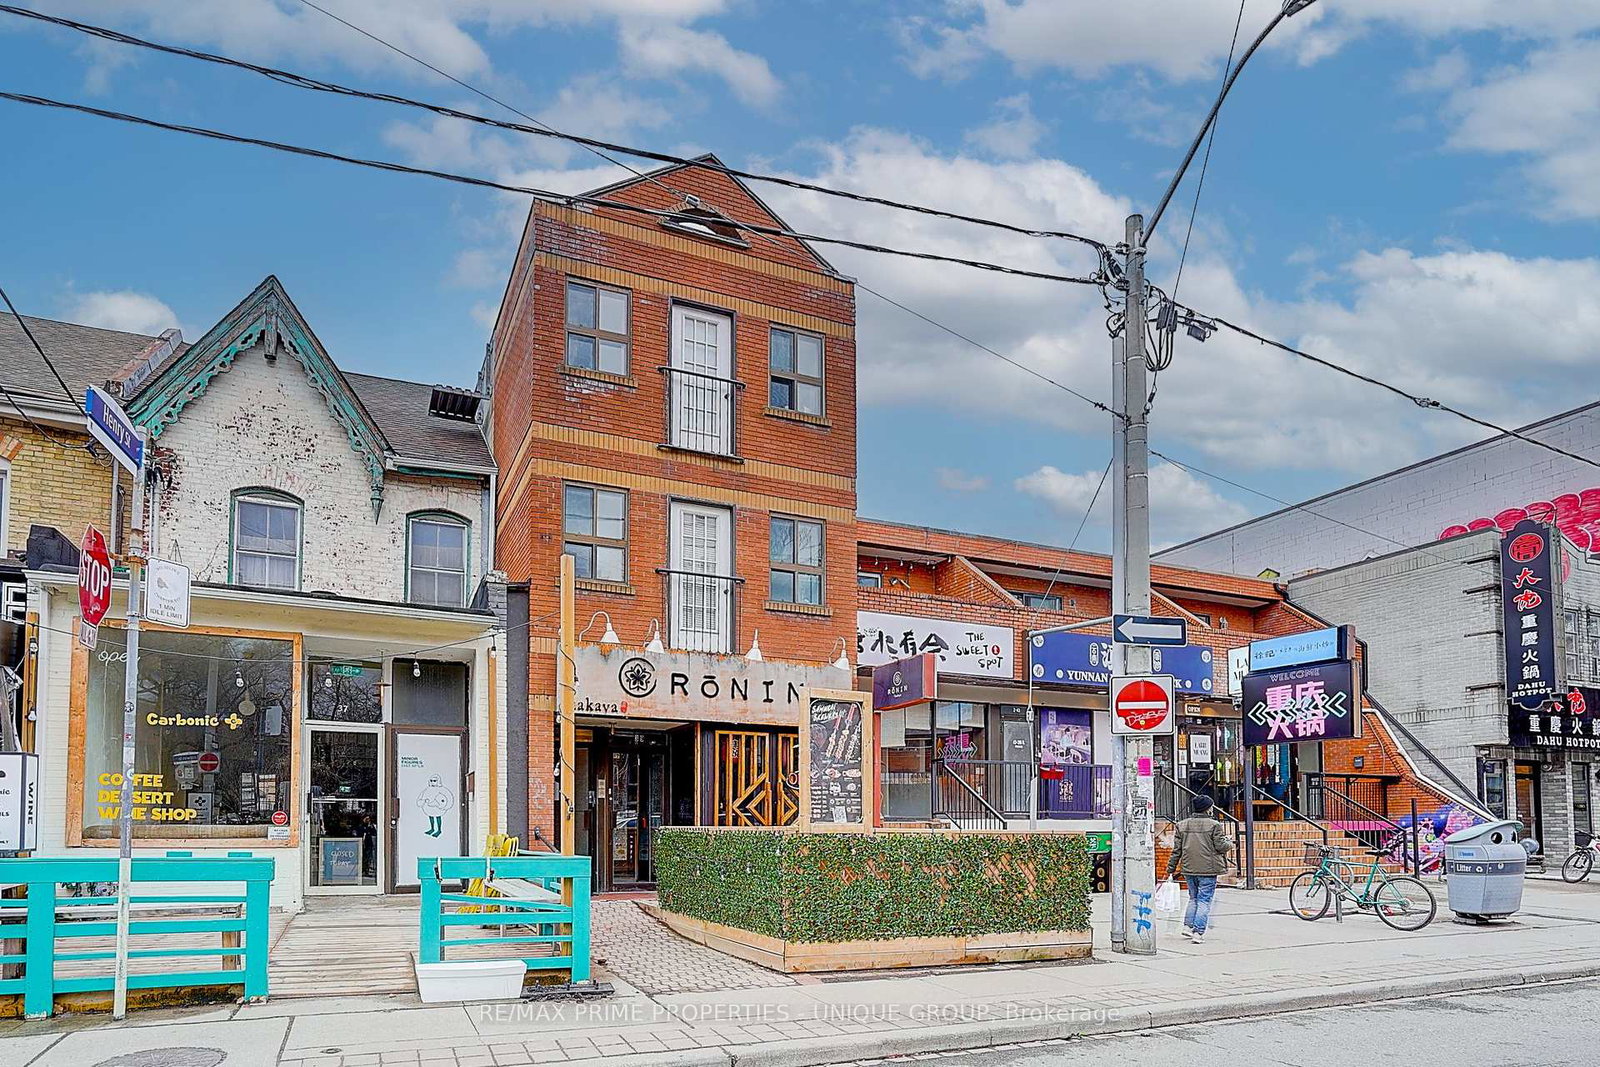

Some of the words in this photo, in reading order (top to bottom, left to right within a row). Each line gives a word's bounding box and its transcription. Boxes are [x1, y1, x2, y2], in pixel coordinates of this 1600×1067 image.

[103, 404, 125, 444] Henry
[124, 431, 131, 448] St
[80, 549, 110, 600] STOP
[166, 612, 183, 620] LIMIT
[965, 632, 984, 642] THE
[956, 644, 989, 656] SWEET
[1066, 670, 1108, 682] YUNNAN
[1270, 668, 1320, 682] WELCOME
[1518, 681, 1546, 690] DAHU
[1512, 688, 1552, 697] HOTPOT
[574, 697, 618, 714] akaya
[146, 712, 220, 727] Carbonic
[1536, 735, 1562, 746] DAHU
[1566, 737, 1600, 748] HOTPOT
[98, 773, 163, 787] COFEE
[98, 790, 174, 804] DESERT
[150, 808, 197, 821] SHOP
[1456, 864, 1472, 872] Litter
